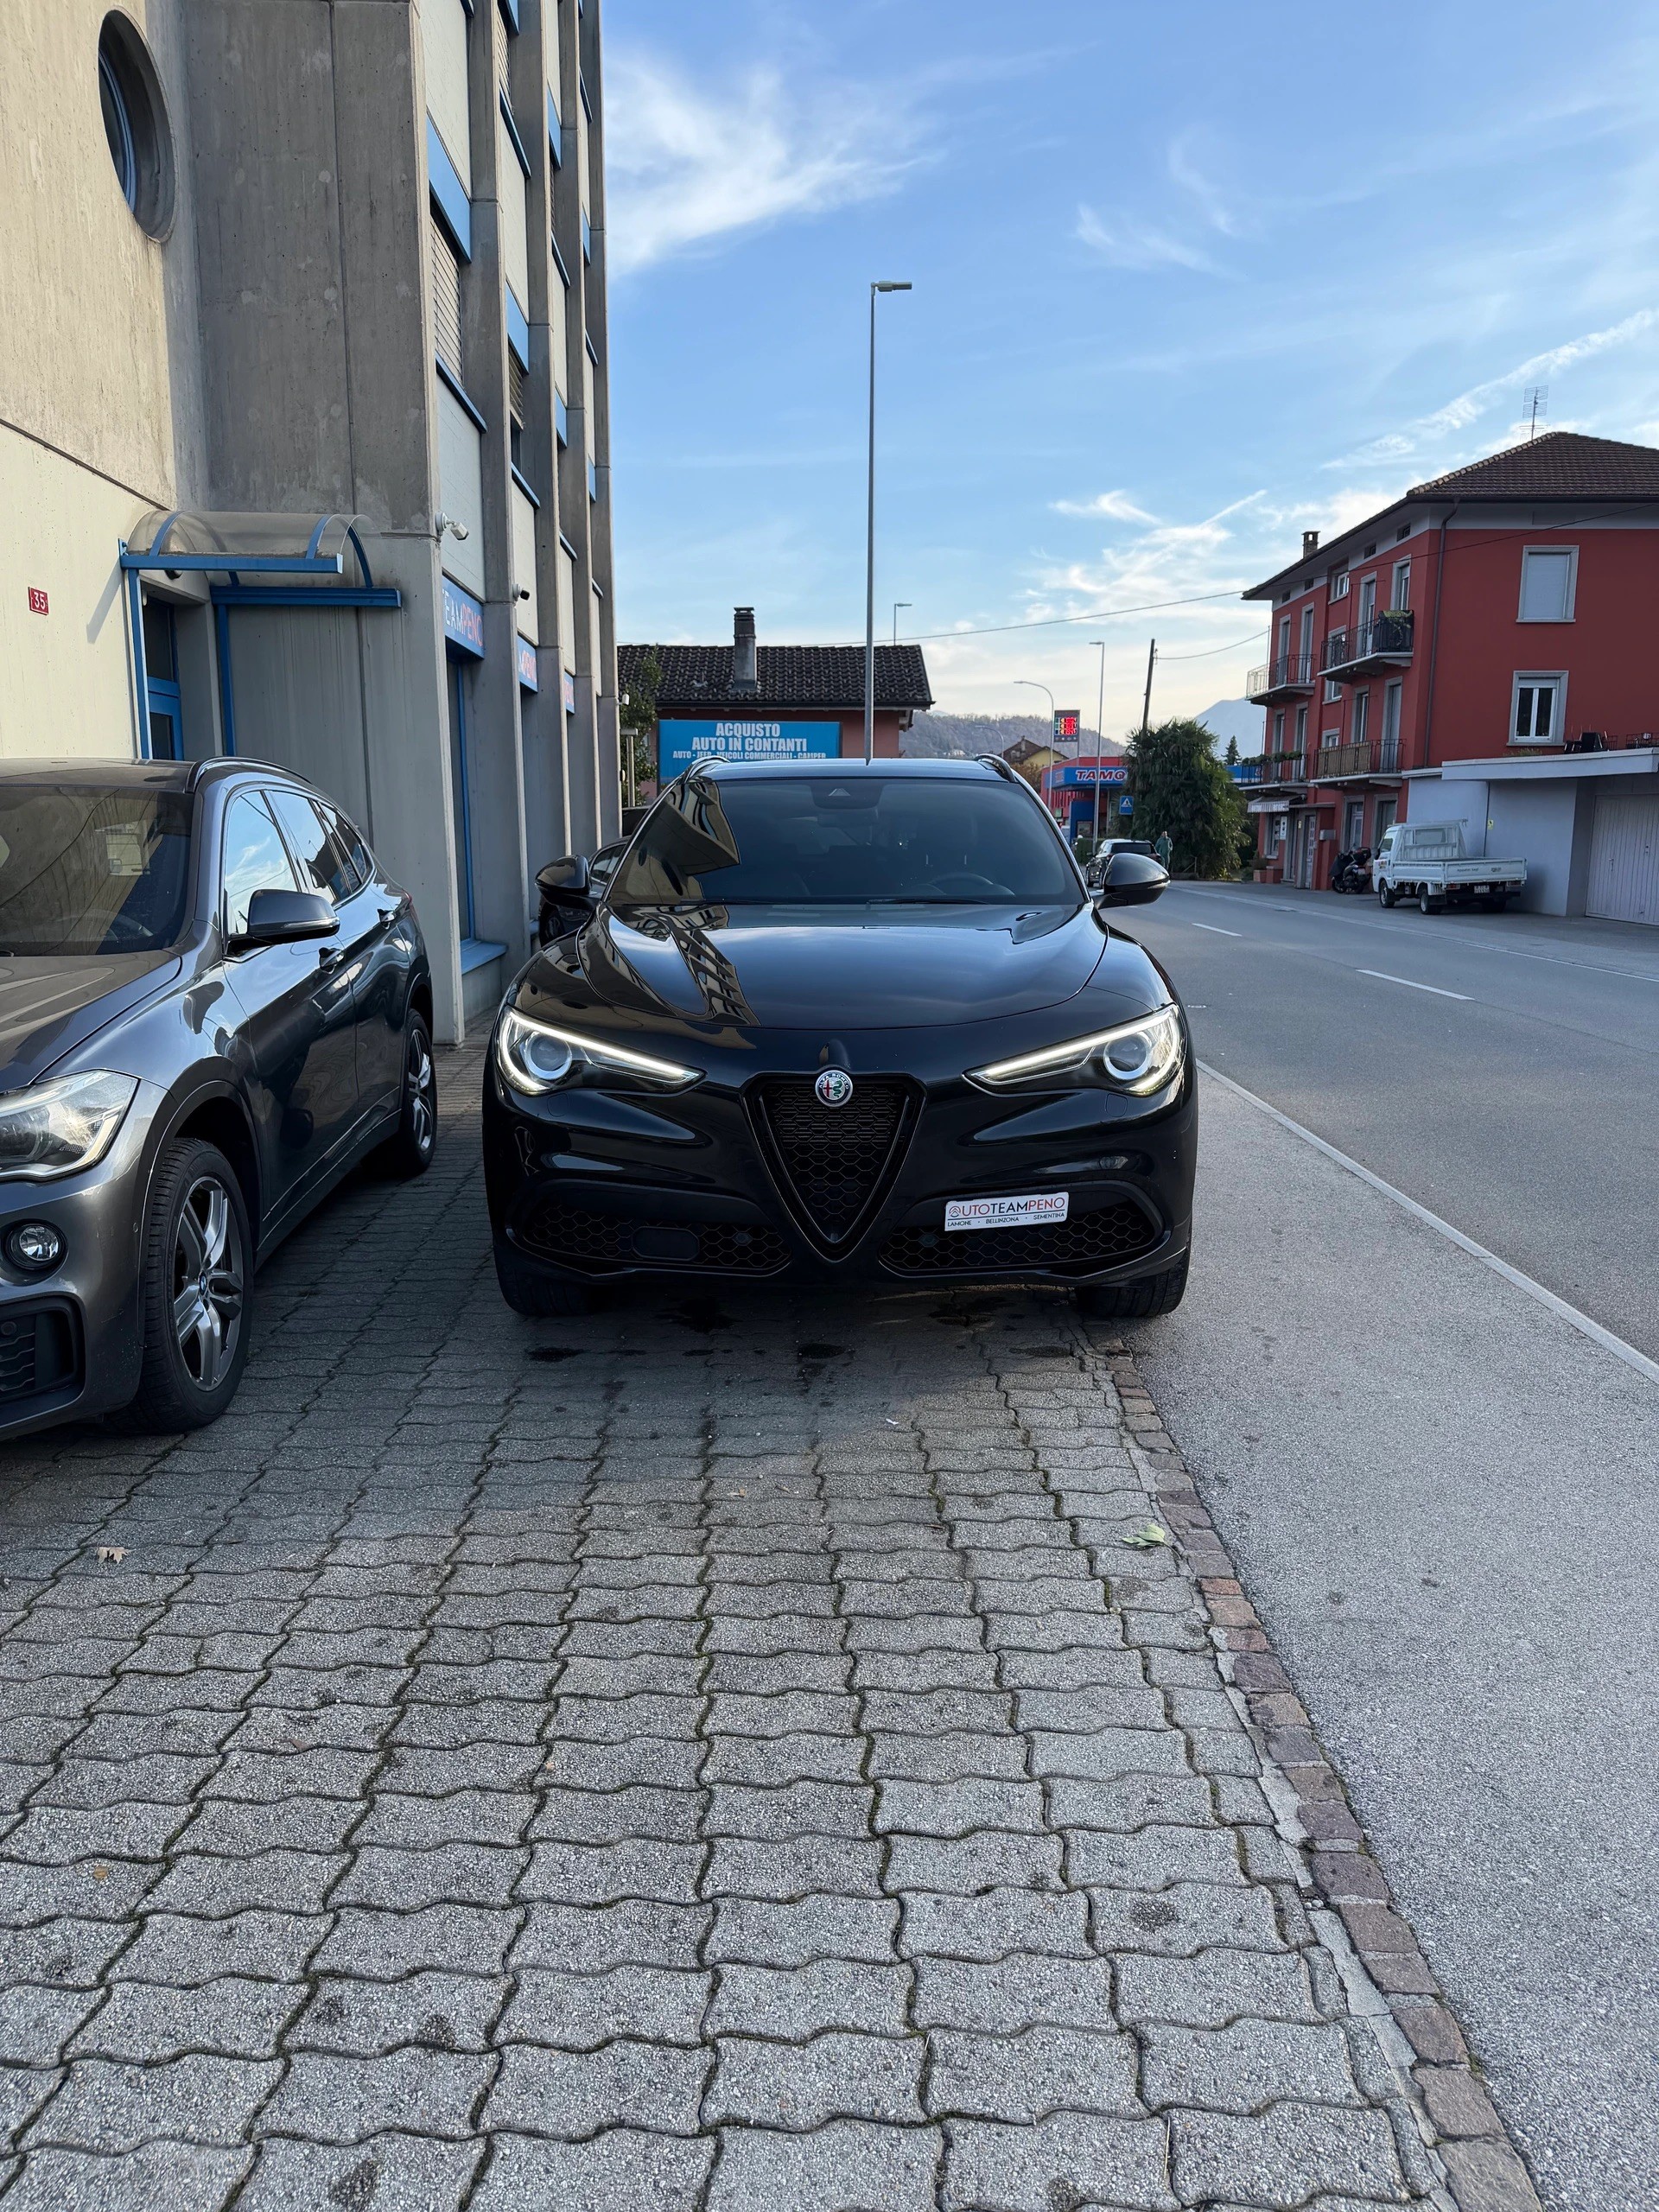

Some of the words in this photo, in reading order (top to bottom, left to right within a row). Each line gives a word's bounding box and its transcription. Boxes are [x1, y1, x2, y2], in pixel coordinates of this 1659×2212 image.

[34, 591, 46, 610] 35
[715, 722, 780, 738] ACQUISTO
[692, 736, 726, 751] AUTO
[728, 737, 742, 751] IN
[745, 738, 807, 752] CONTANTI
[673, 750, 691, 759] AUTO
